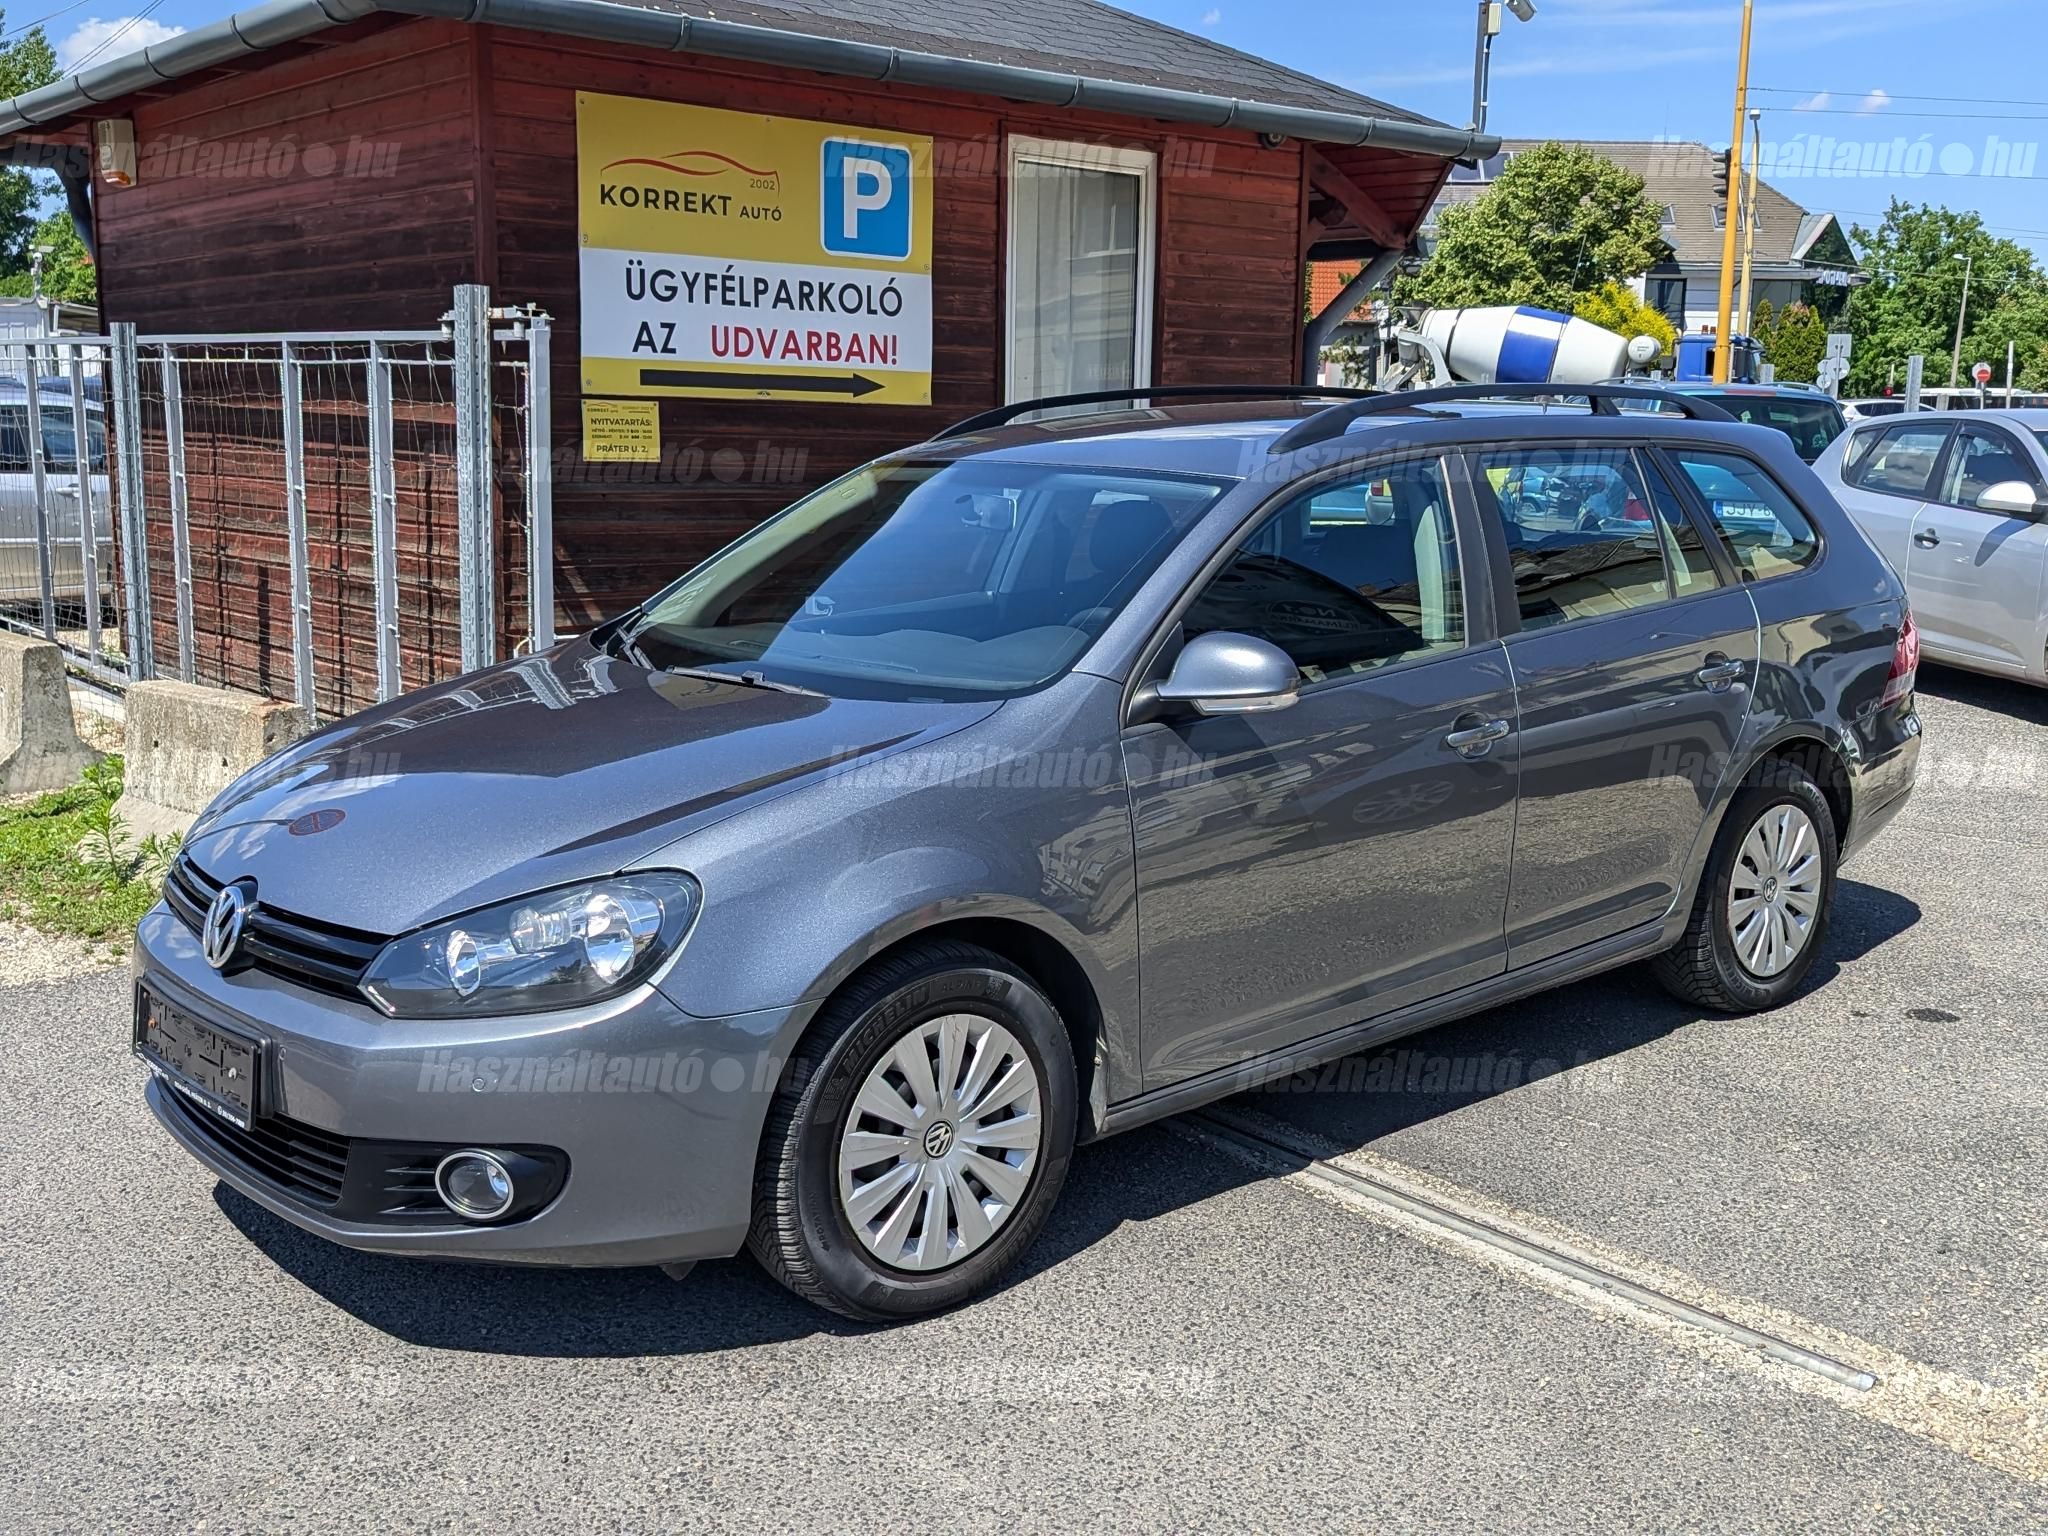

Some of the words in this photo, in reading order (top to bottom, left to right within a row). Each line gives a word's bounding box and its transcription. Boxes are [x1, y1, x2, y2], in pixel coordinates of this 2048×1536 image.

[600, 184, 732, 217] KORREKT
[739, 204, 783, 222] AUTÓ
[749, 178, 775, 191] 2002
[843, 157, 892, 239] P
[626, 259, 903, 317] ÜGYFÉLPARKOLÓ
[632, 320, 677, 354] AZ
[711, 324, 899, 366] UDVARBAN!
[590, 417, 653, 427] NYITVATARTÁS:
[596, 444, 630, 453] PRÁTER
